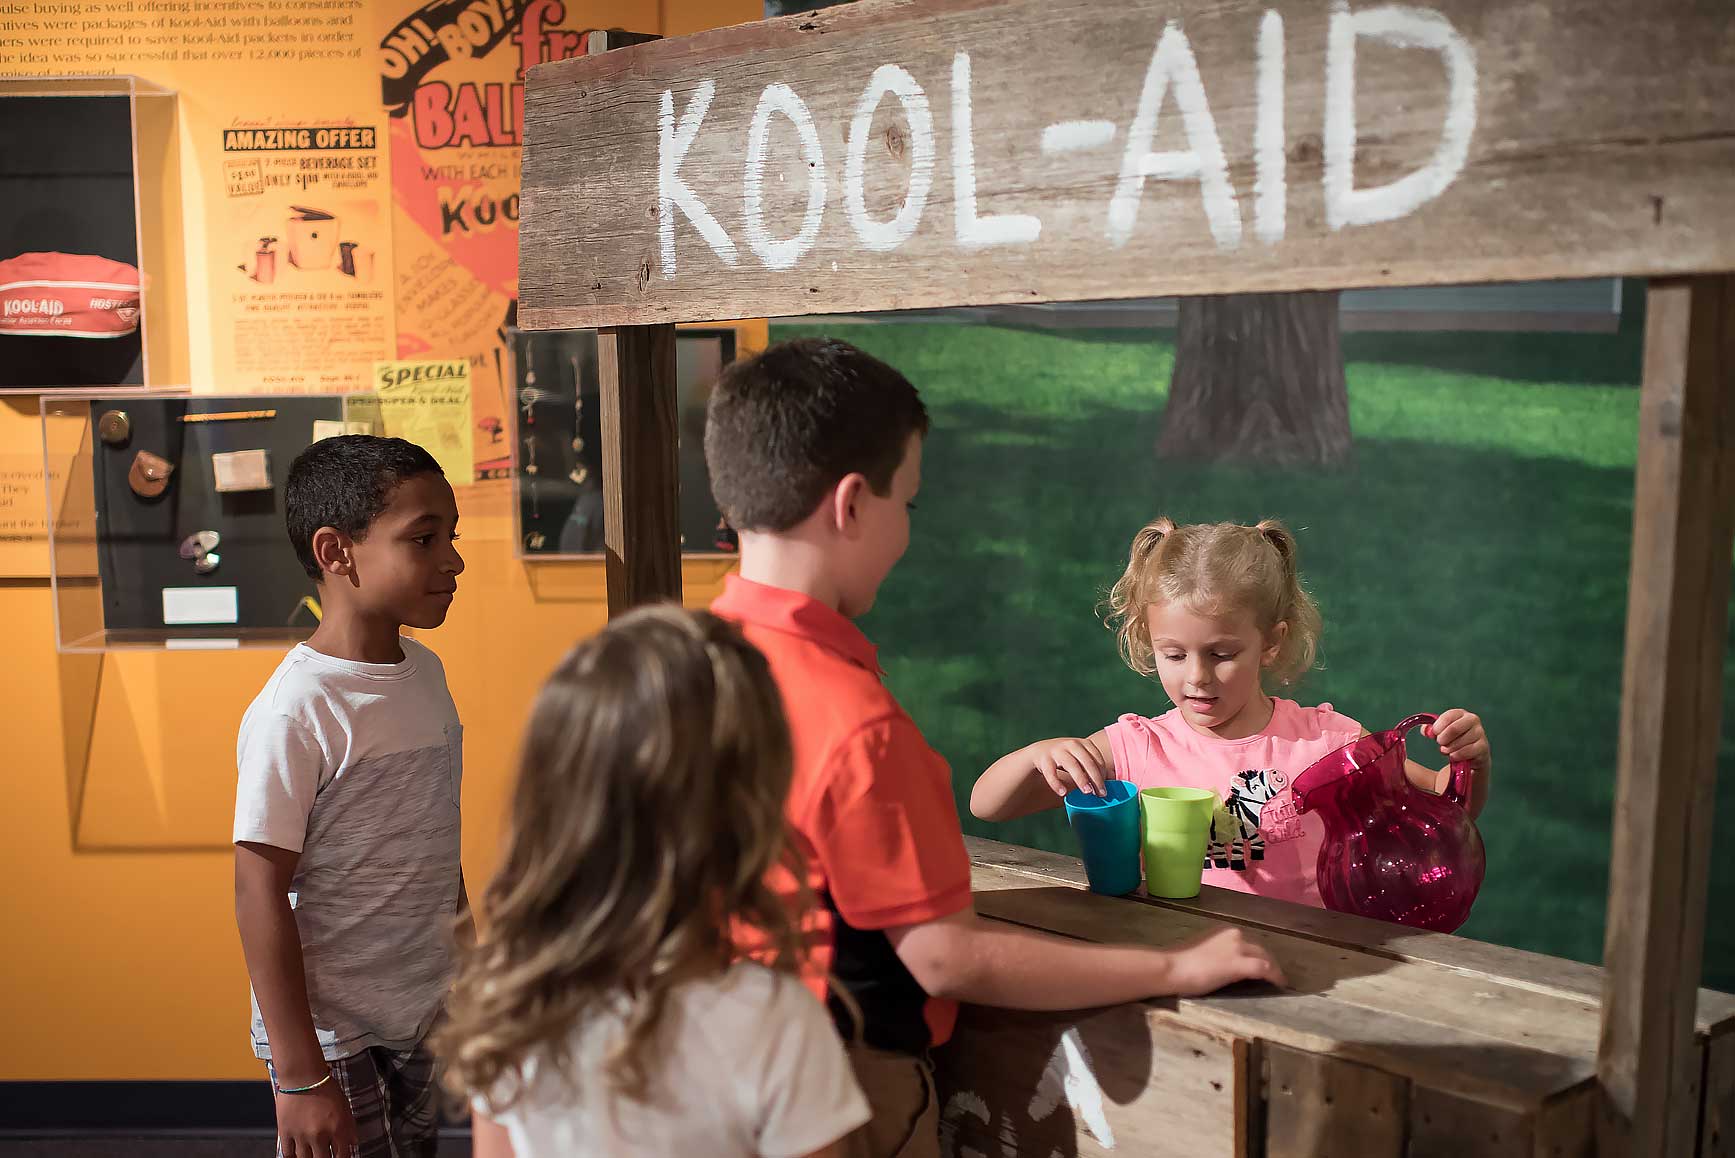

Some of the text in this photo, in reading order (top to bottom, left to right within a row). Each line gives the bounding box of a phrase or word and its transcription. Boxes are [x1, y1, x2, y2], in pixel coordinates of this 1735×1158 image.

[0, 2, 29, 14] ulse
[34, 1, 81, 15] buying
[85, 3, 100, 13] as
[105, 1, 134, 13] well
[138, 0, 191, 13] offering
[194, 0, 265, 11] incentives
[268, 0, 282, 10] to
[43, 22, 77, 31] were
[82, 18, 147, 33] packages
[151, 16, 164, 29] of
[169, 16, 227, 28] Kool-Aid
[231, 15, 260, 27] with
[264, 15, 323, 27] balloons
[327, 14, 353, 26] and
[28, 38, 63, 48] were
[66, 34, 124, 49] required
[128, 34, 142, 46] to
[145, 35, 179, 45] save
[182, 32, 240, 45] Kool-Aid
[243, 32, 297, 46] packets
[301, 32, 314, 43] in
[317, 31, 353, 43] order
[381, 18, 441, 79] OH!
[0, 51, 15, 64] he
[19, 51, 49, 64] idea
[53, 52, 82, 63] was
[86, 53, 102, 63] so
[106, 49, 178, 62] successful
[182, 49, 207, 61] that
[212, 50, 242, 61] over
[299, 48, 344, 63] pieces
[225, 128, 375, 150] AMAZING OFFER
[659, 1, 1478, 281] KOOL-AID
[358, 156, 377, 169] SET
[421, 163, 508, 180] WITH EACH
[380, 363, 467, 390] SPECIAL
